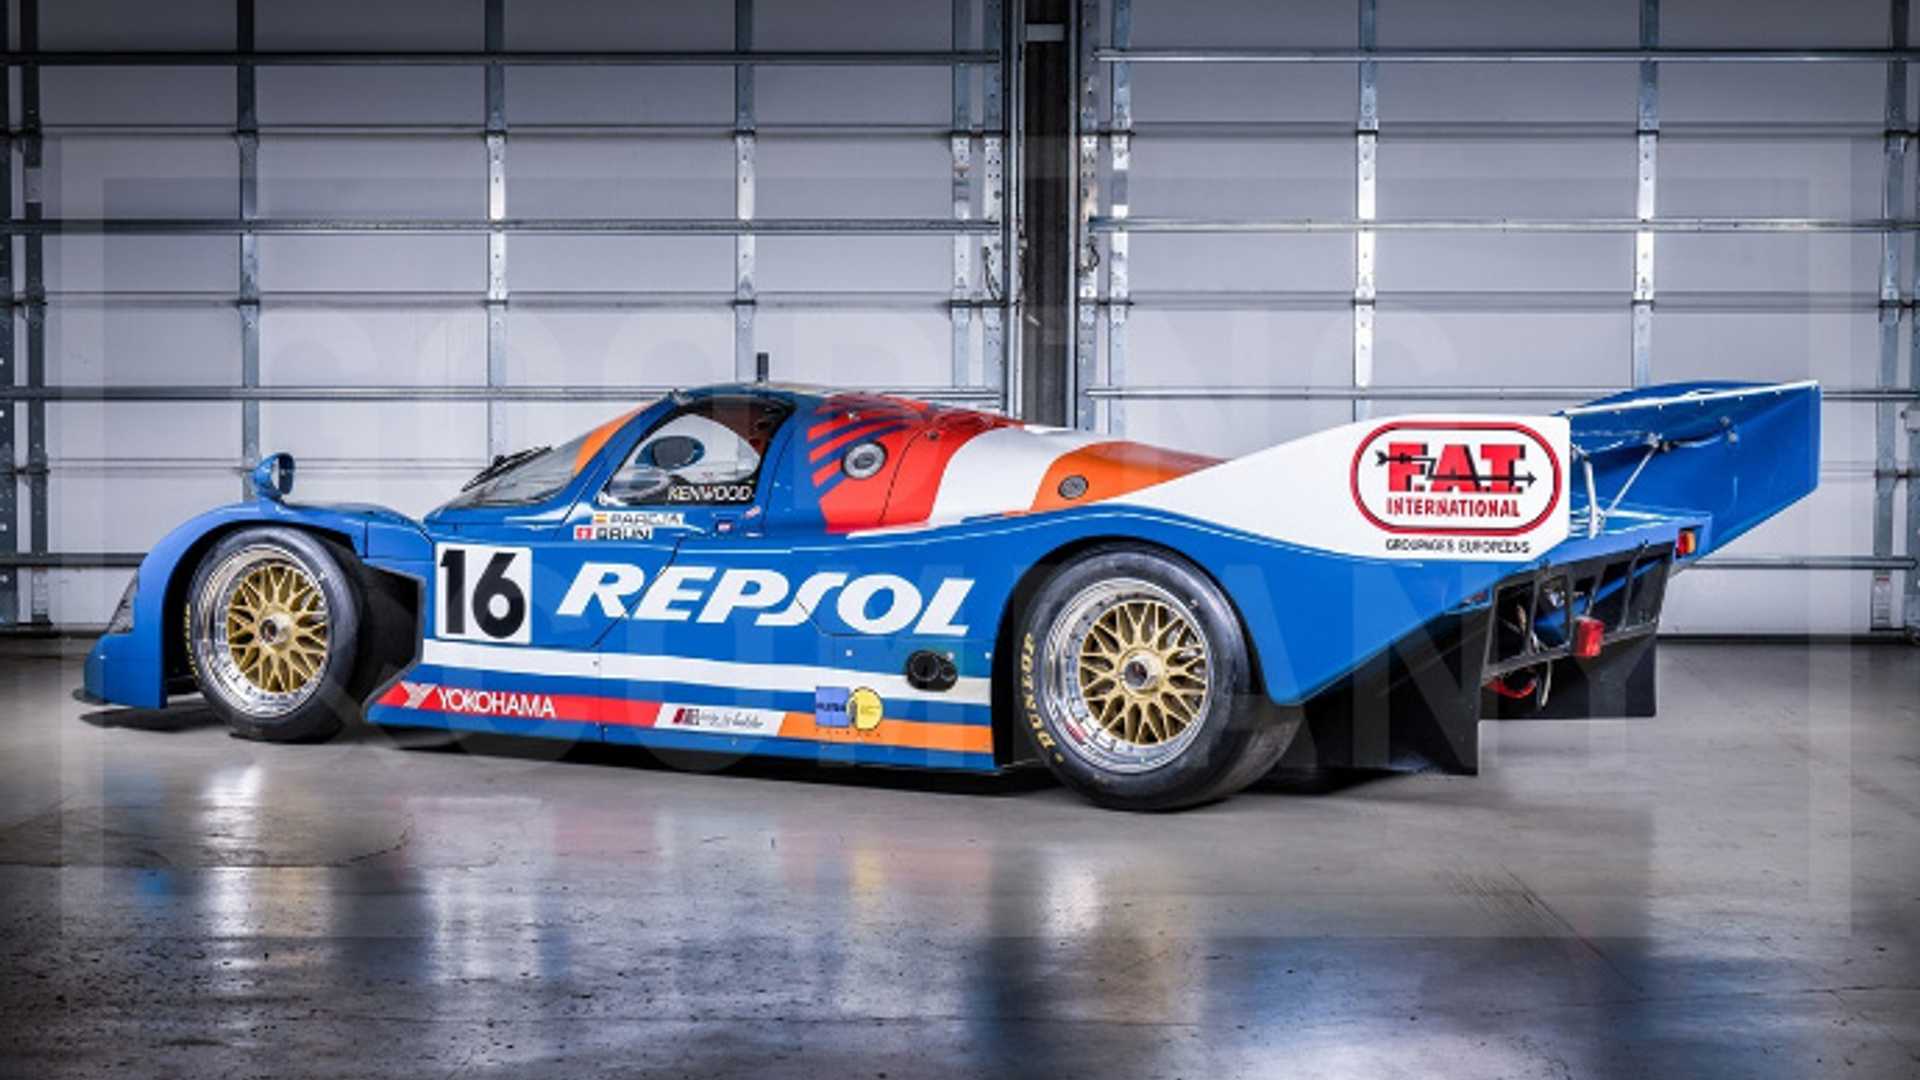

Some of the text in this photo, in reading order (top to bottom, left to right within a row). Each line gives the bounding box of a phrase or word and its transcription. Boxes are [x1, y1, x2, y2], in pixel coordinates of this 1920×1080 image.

[667, 485, 752, 502] KENWOOD
[1386, 497, 1521, 518] INTERNATIONAL
[440, 548, 526, 638] 16
[556, 562, 975, 636] REPSOL
[436, 687, 556, 718] YOKOHAMA
[1021, 632, 1056, 749] DUNLOP
